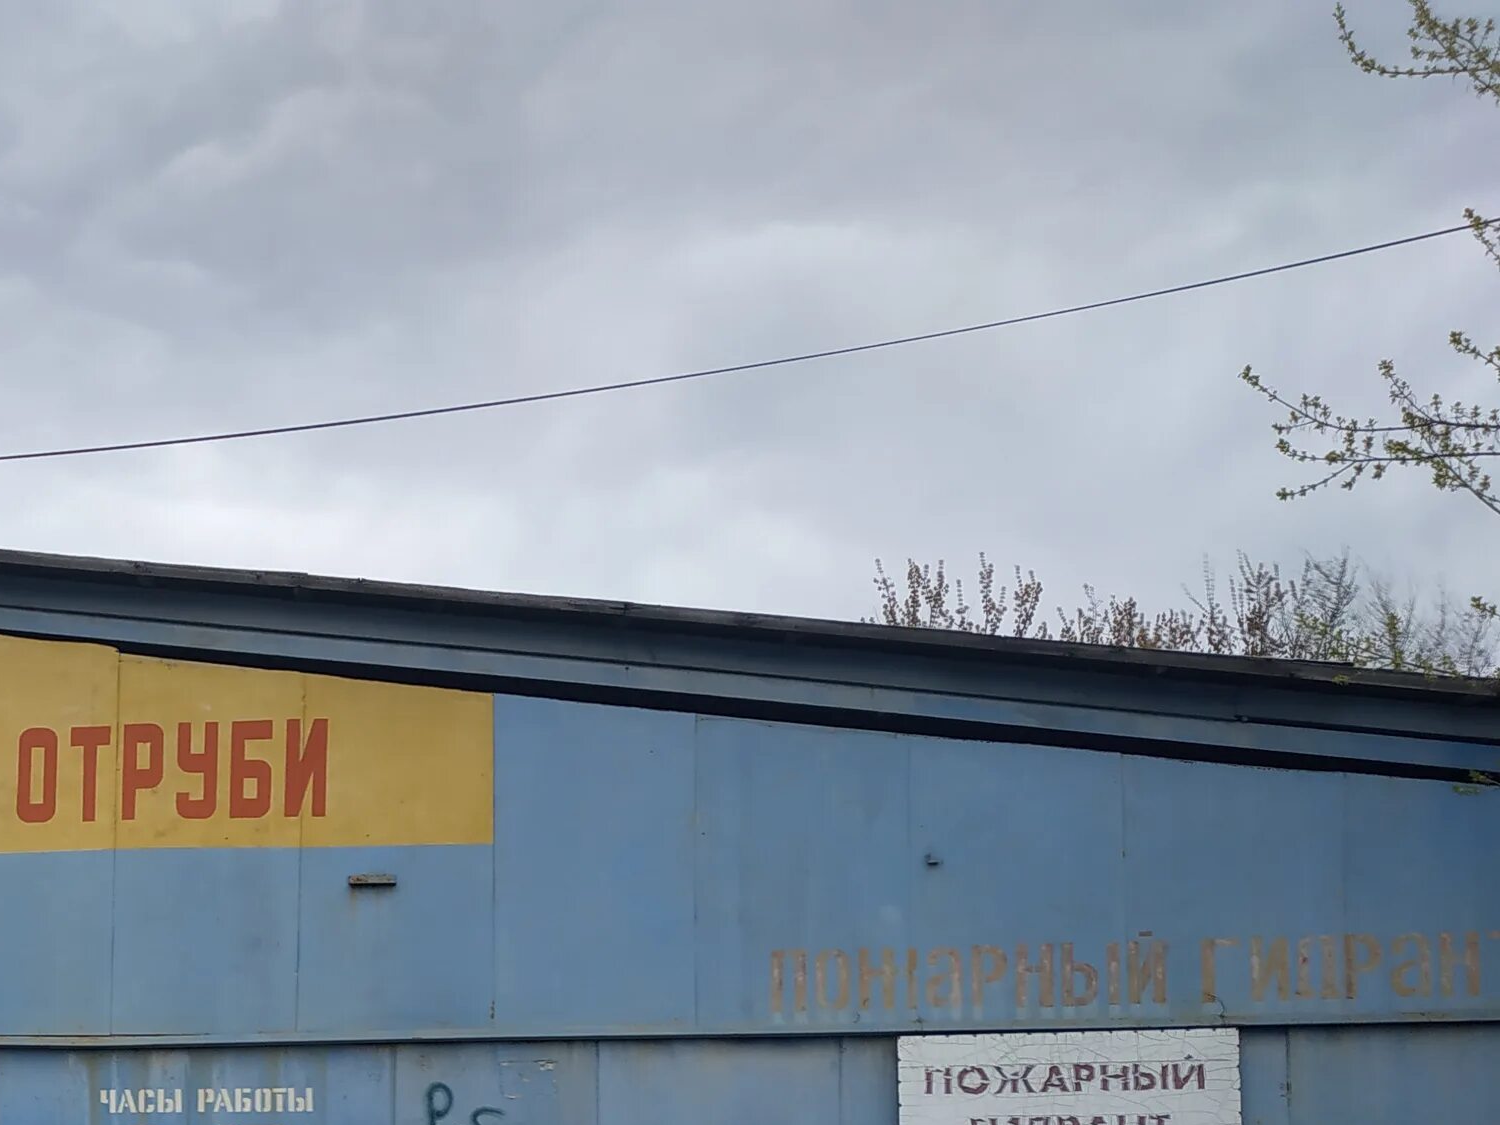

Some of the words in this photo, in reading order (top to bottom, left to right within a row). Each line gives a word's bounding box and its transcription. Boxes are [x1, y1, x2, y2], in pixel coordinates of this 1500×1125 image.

[15, 718, 330, 824] ОТРУБИ
[1201, 929, 1500, 1004] ГИДРАН
[100, 1088, 183, 1114] ЧАСЫ
[197, 1087, 314, 1113] РАБОТЫ
[923, 1053, 1206, 1096] ПОЖАРНЫЙ
